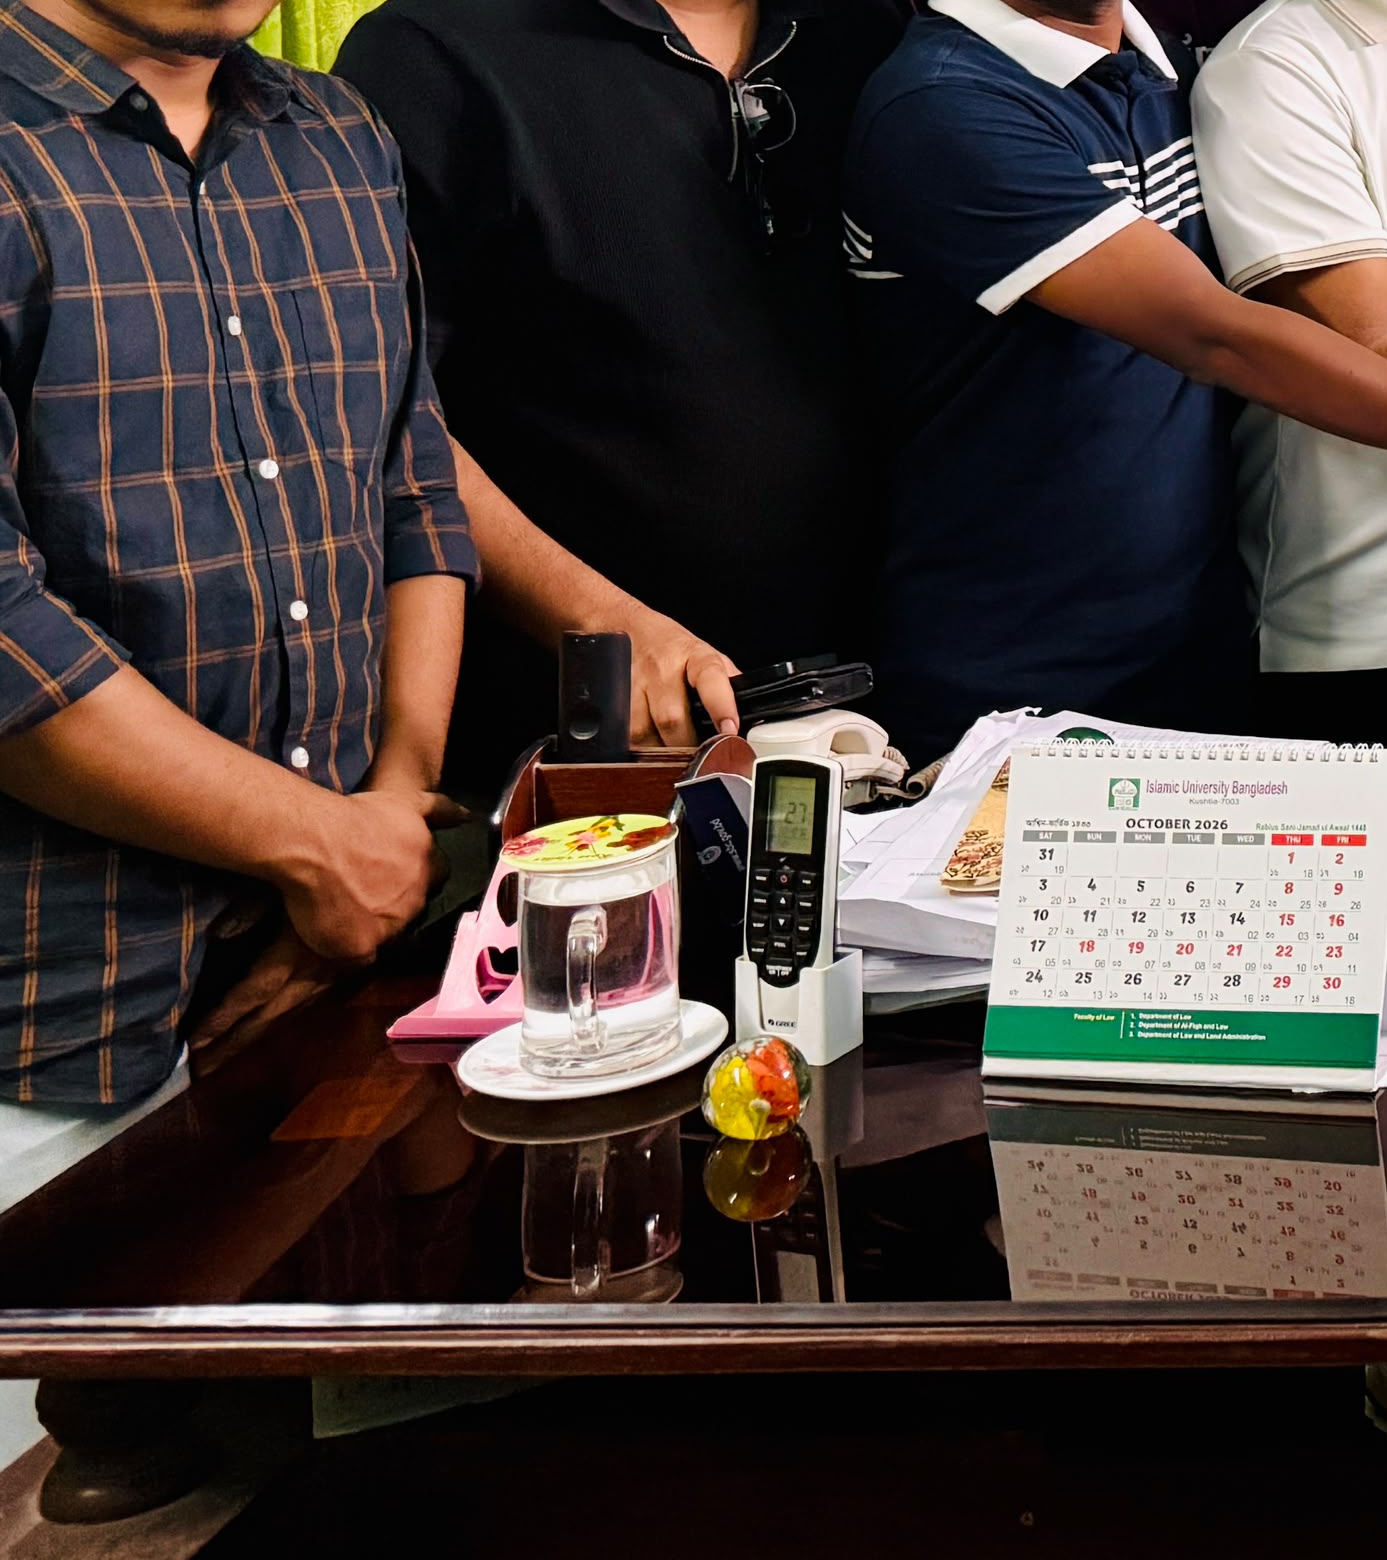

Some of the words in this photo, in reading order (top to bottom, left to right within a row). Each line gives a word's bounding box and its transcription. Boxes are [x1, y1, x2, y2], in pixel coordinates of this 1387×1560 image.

[1146, 779, 1179, 794] Islamic
[1182, 780, 1230, 797] University
[1232, 780, 1288, 798] Bangladesh
[784, 802, 807, 824] 27
[1126, 818, 1191, 829] OCTOBER
[1195, 820, 1228, 830] 2026
[1039, 832, 1053, 840] SAT
[1237, 835, 1254, 843] WED
[1336, 836, 1350, 844] FRI
[1039, 848, 1054, 860] 31
[1288, 851, 1295, 864] 1
[1335, 853, 1344, 865] 2
[1039, 879, 1048, 891] 3
[1088, 878, 1096, 891] 4
[1137, 880, 1145, 892] 5
[1186, 880, 1195, 893] 6
[1235, 882, 1244, 894] 7
[1284, 882, 1294, 894] 8
[1334, 883, 1343, 895] 9
[1033, 909, 1049, 921] 10
[1083, 910, 1097, 922] 11
[1131, 911, 1146, 923] 12
[1180, 912, 1196, 924] 13
[1230, 912, 1246, 925] 14
[1279, 913, 1295, 926] 15
[1329, 914, 1345, 927] 16
[1030, 940, 1046, 952] 17
[1079, 940, 1095, 953] 18
[1128, 941, 1144, 954] 19
[1176, 943, 1194, 955] 20
[1226, 944, 1243, 956] 21
[1275, 945, 1293, 957] 22
[1325, 946, 1343, 958] 23
[1025, 969, 1043, 983] 24
[1075, 972, 1092, 984] 25
[1124, 973, 1142, 985] 26
[1174, 974, 1192, 986] 27
[1223, 974, 1241, 987] 28
[1273, 976, 1291, 988] 29
[1323, 977, 1341, 989] 30
